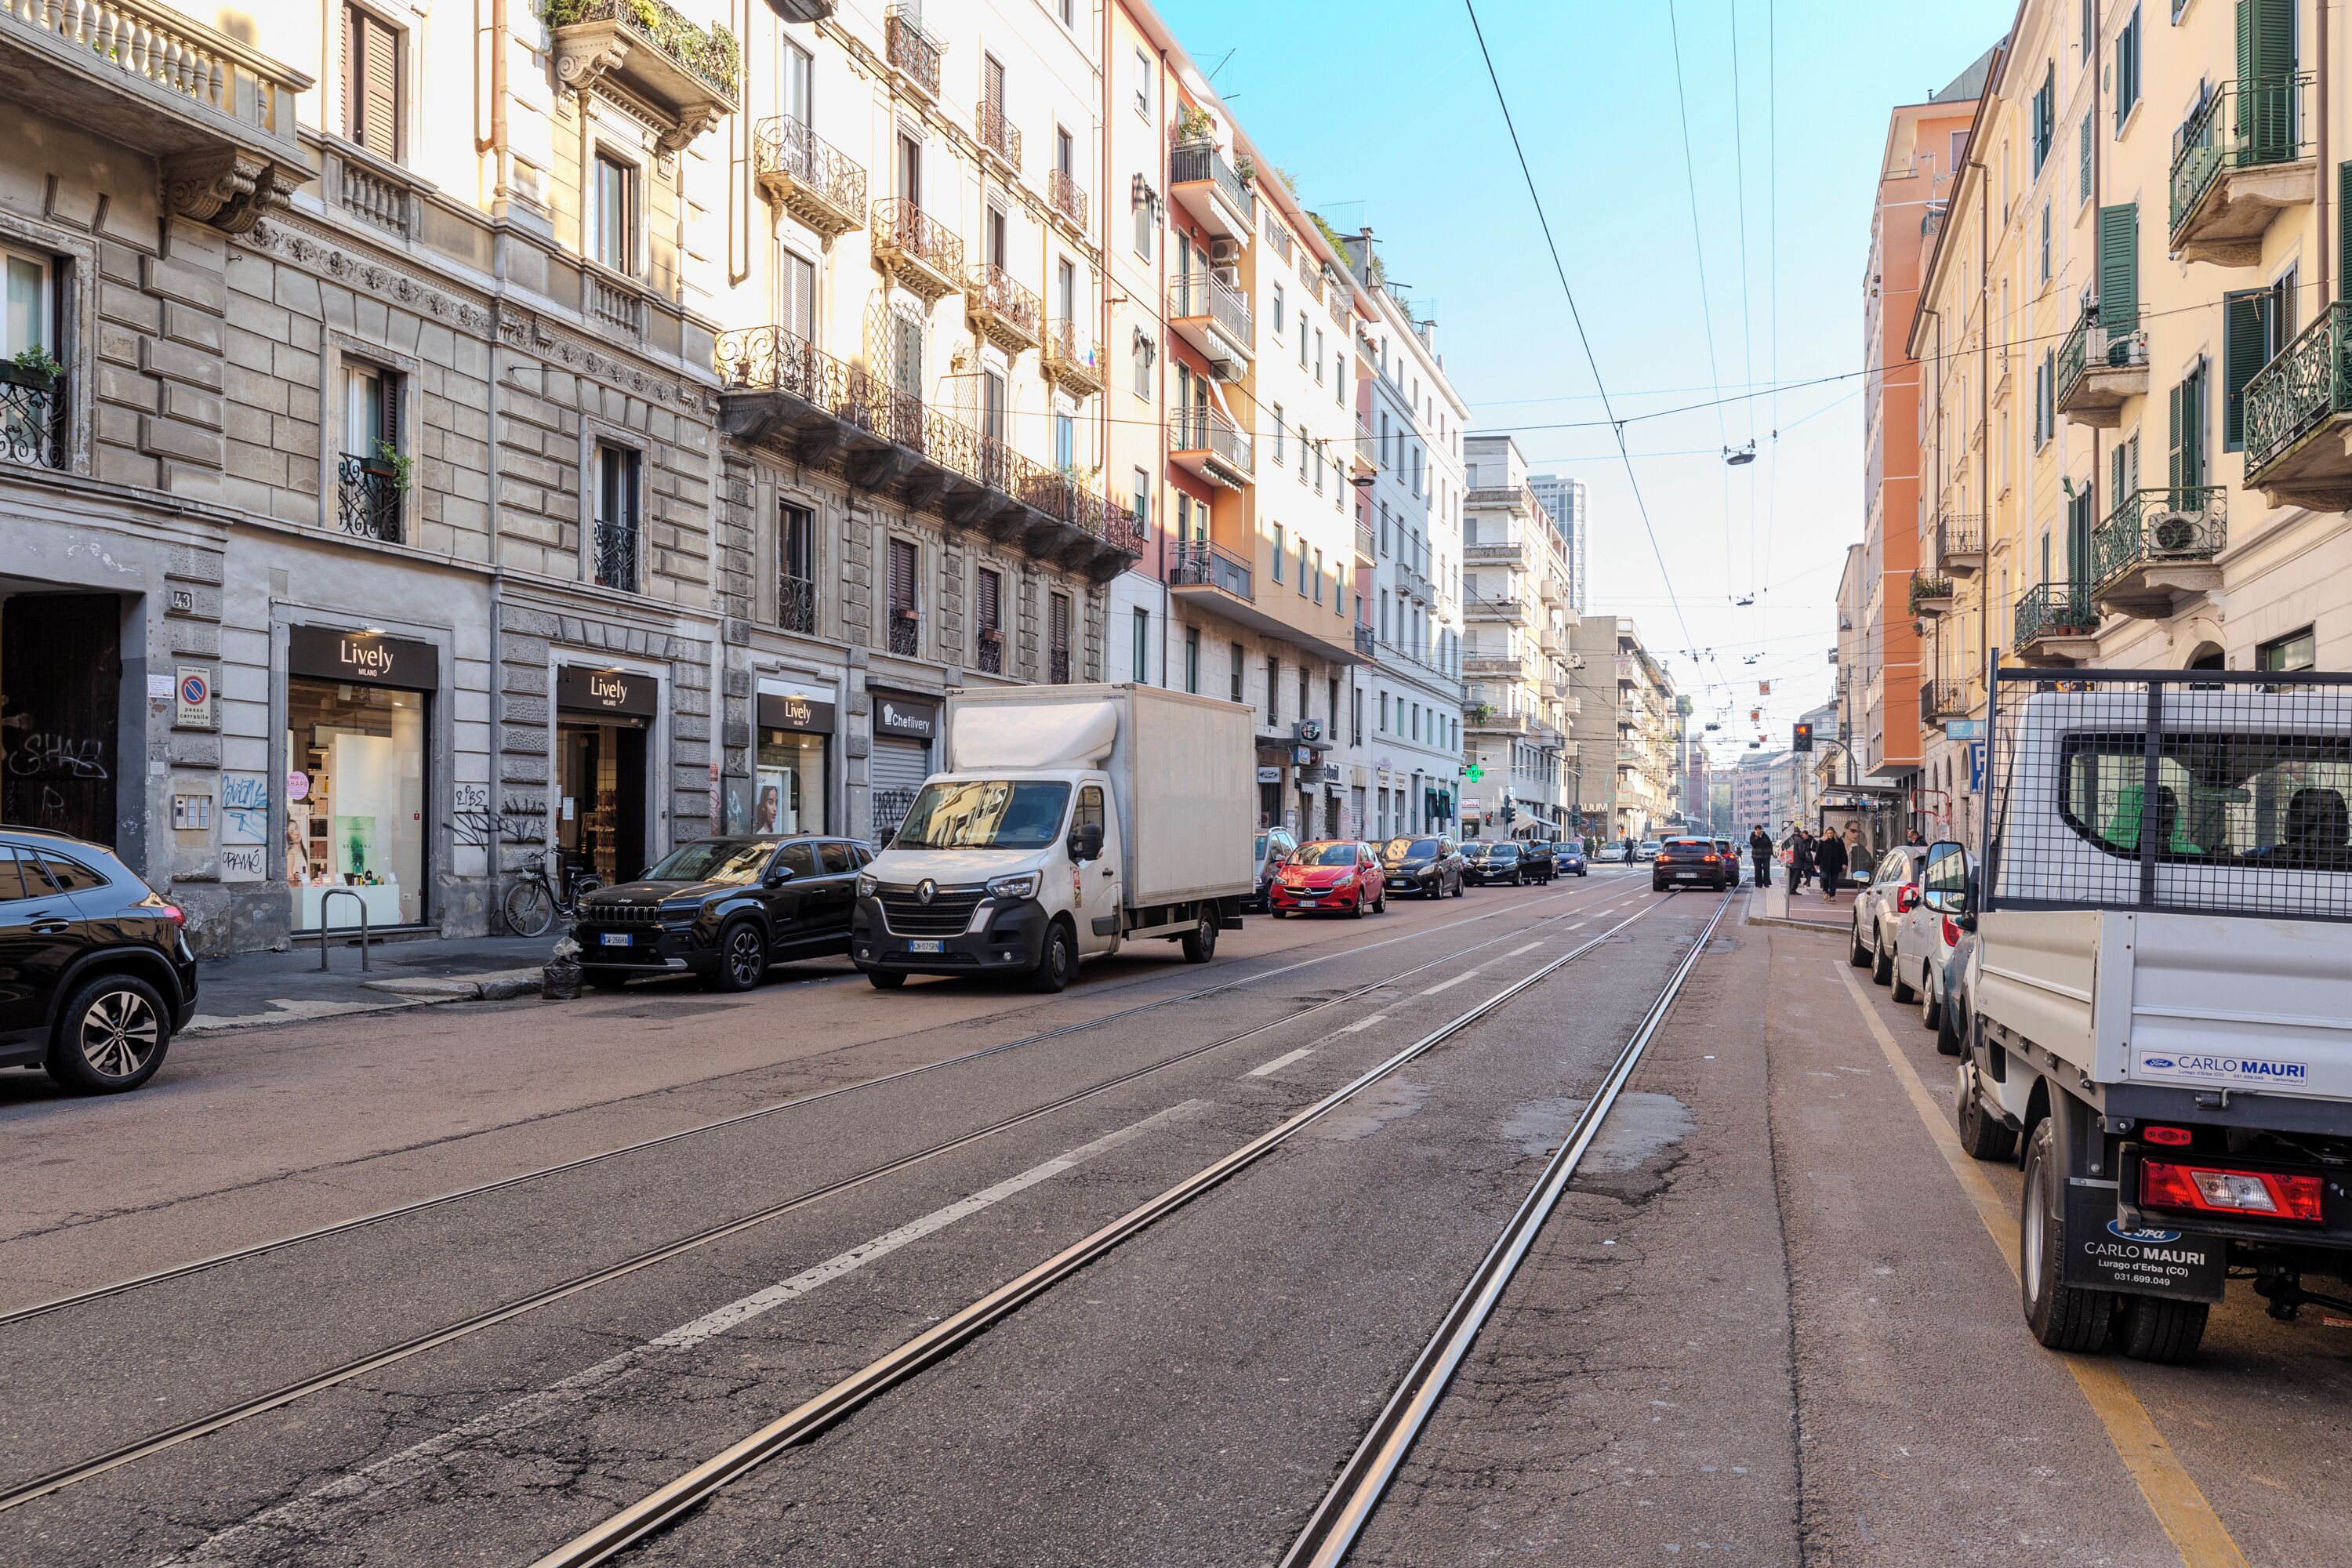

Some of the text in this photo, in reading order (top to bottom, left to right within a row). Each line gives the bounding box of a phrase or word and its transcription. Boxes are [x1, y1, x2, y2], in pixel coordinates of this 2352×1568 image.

[175, 593, 191, 608] 43
[341, 640, 394, 674] Lively
[358, 668, 377, 677] MILANO
[591, 676, 627, 704] Lively
[786, 701, 811, 724] Lively
[892, 713, 930, 734] Cheflivery
[2149, 1058, 2169, 1067] Ford
[2179, 1056, 2305, 1078] CARLO MAURI
[2085, 1242, 2205, 1265] CARLO MAURI
[2098, 1259, 2189, 1278] Lurago d'Erba (CO)
[2114, 1272, 2171, 1286] 031.699.049
